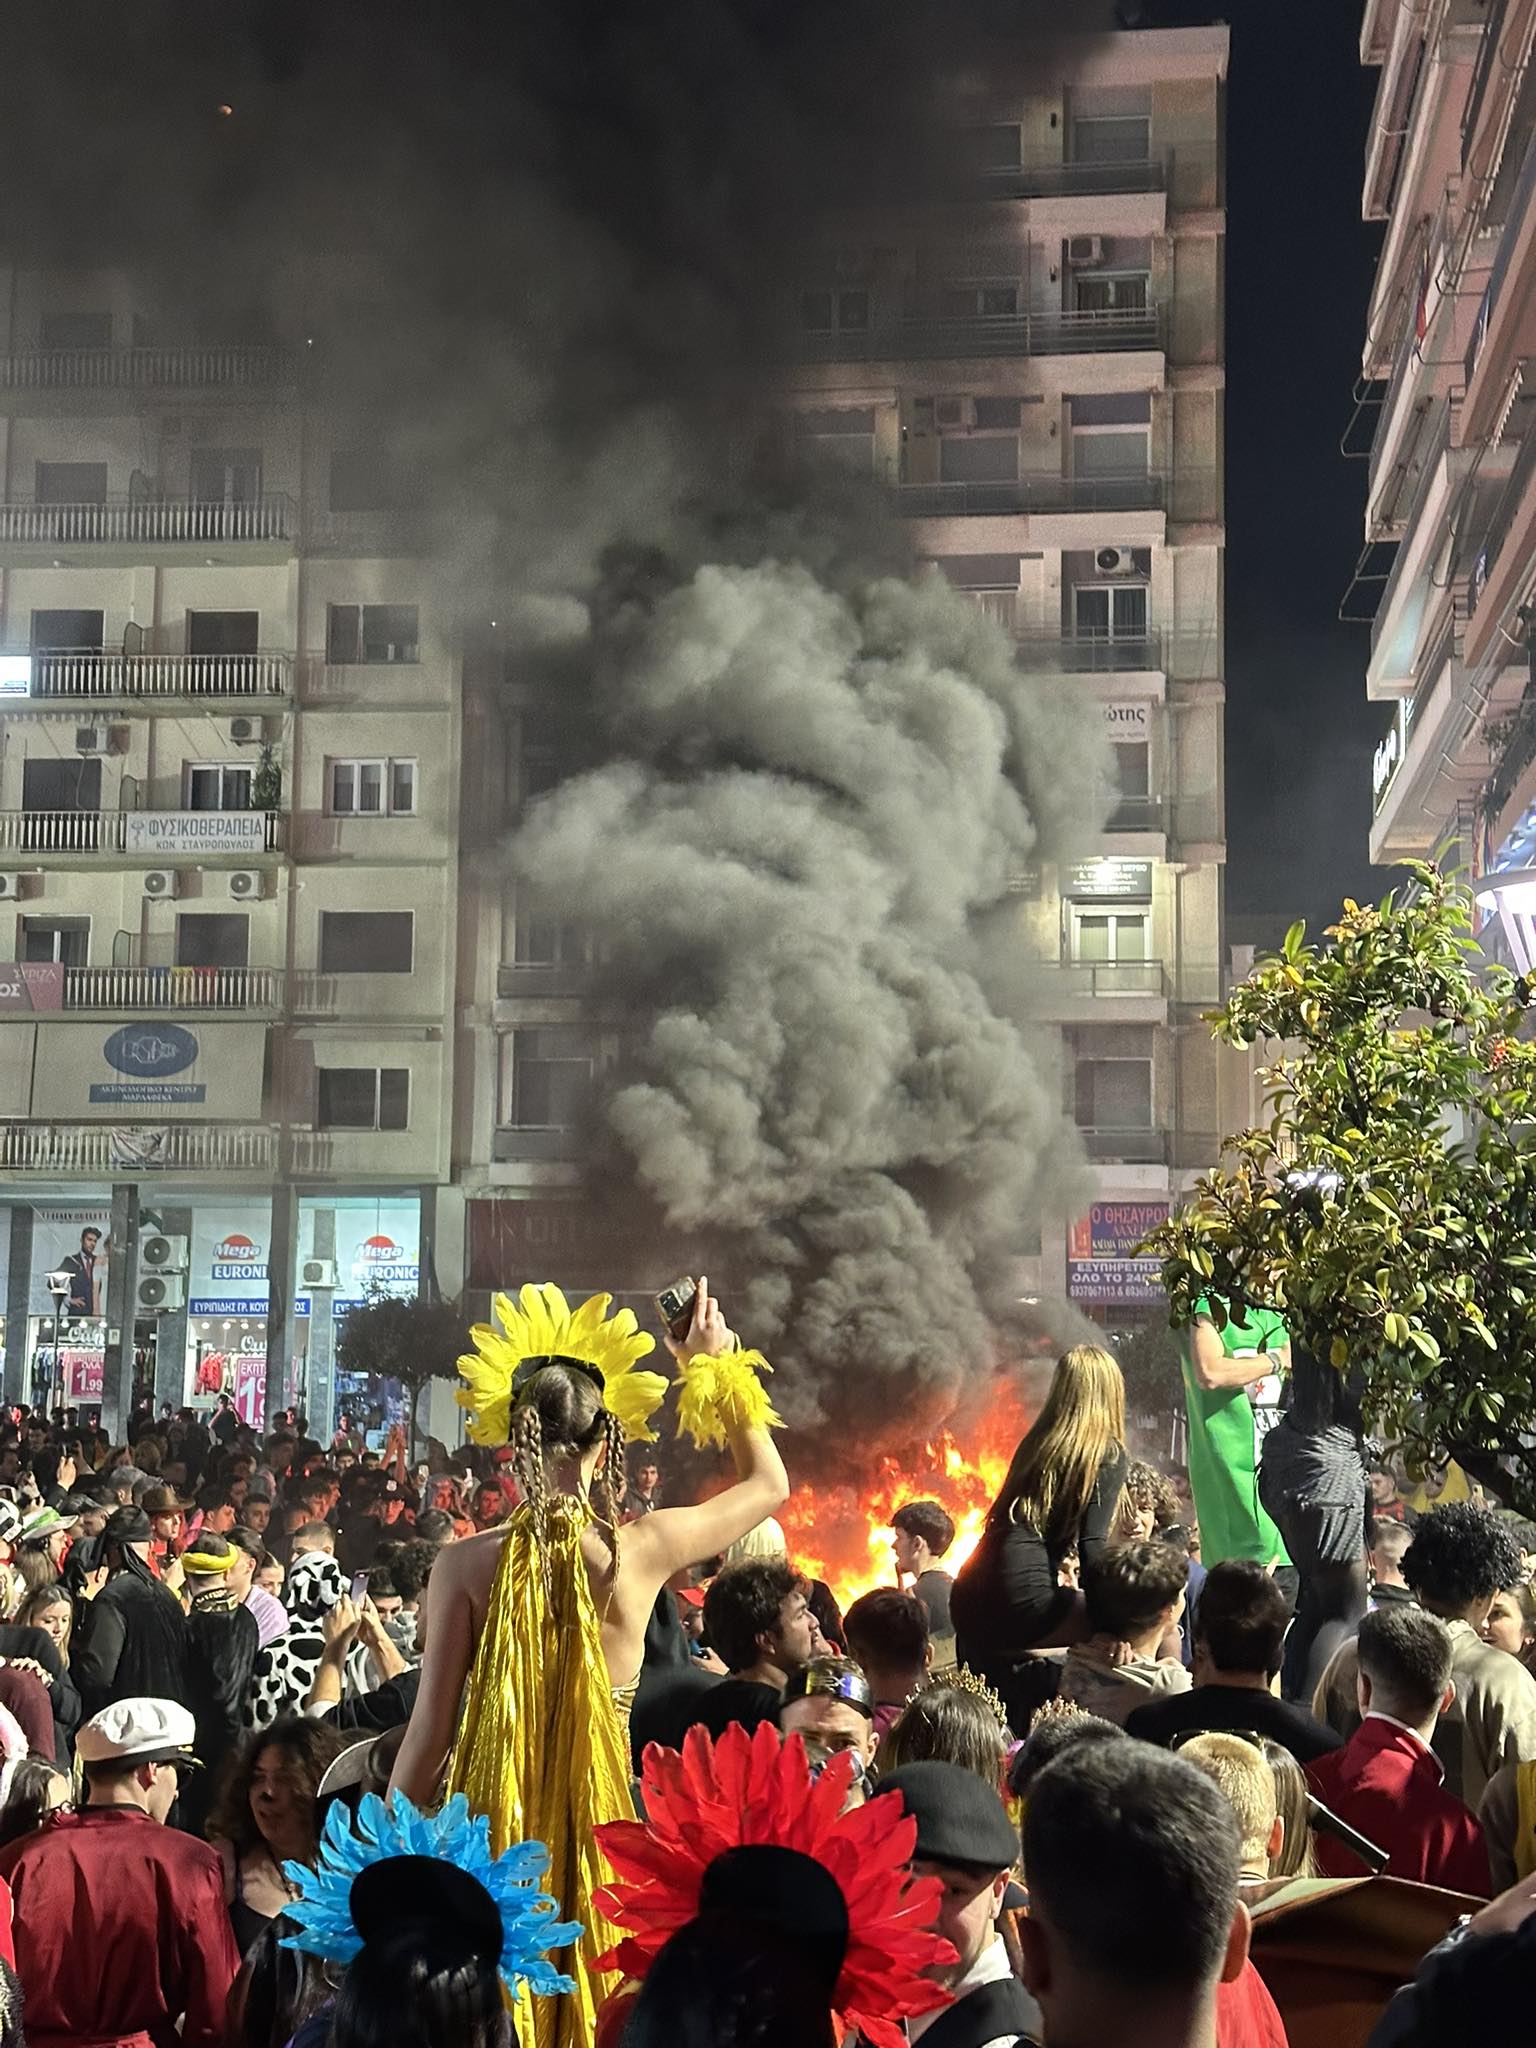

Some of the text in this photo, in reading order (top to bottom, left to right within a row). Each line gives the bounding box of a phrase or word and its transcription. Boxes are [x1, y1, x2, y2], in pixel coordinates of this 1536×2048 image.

[148, 818, 262, 837] ΦΥΣΙΚΟΘΕΡΑΠΕΙΑ
[182, 840, 255, 850] ΣΤΑΥΡΟΠΟΥΛΟΣ
[213, 1243, 261, 1258] Mega
[355, 1244, 403, 1259] Mega
[1072, 1273, 1100, 1283] ΟΛΟ
[1103, 1273, 1122, 1283] ΤΟ
[194, 1301, 236, 1313] ΕΥΡΙΠΙΔΗΣ
[238, 1301, 248, 1313] ΓΡ.
[76, 1368, 104, 1392] 1.99
